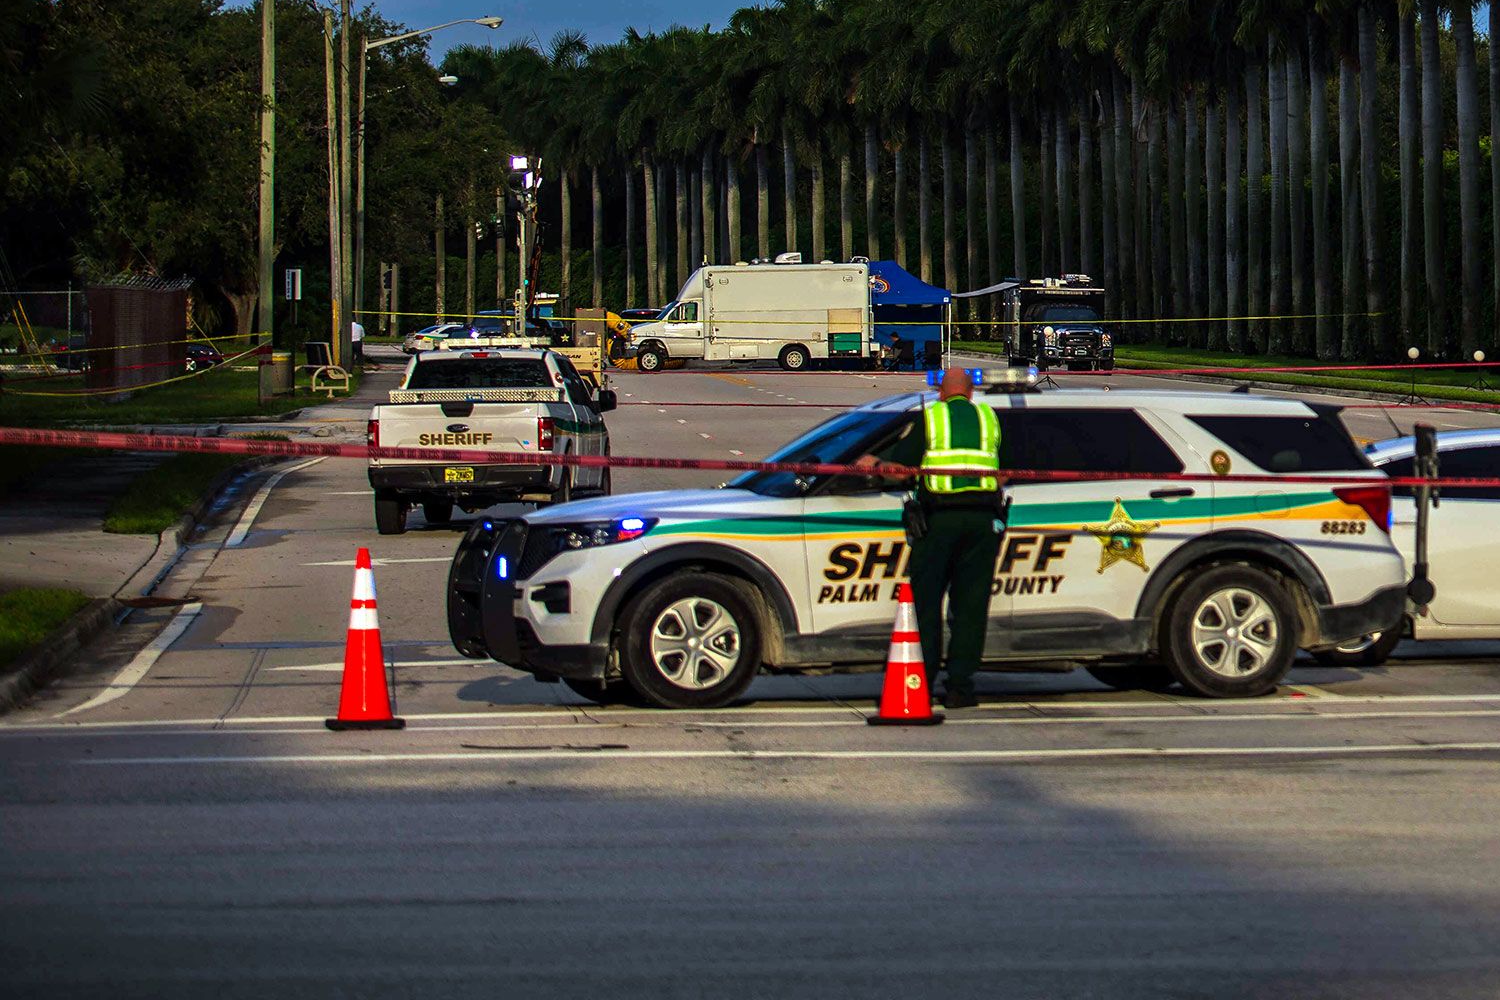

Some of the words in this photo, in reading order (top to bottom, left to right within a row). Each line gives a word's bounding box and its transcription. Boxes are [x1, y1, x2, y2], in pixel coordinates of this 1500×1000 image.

[418, 432, 493, 446] SHERIFF
[1320, 520, 1367, 535] 88283
[817, 582, 880, 604] PALM
[990, 574, 1064, 597] OUNTY
